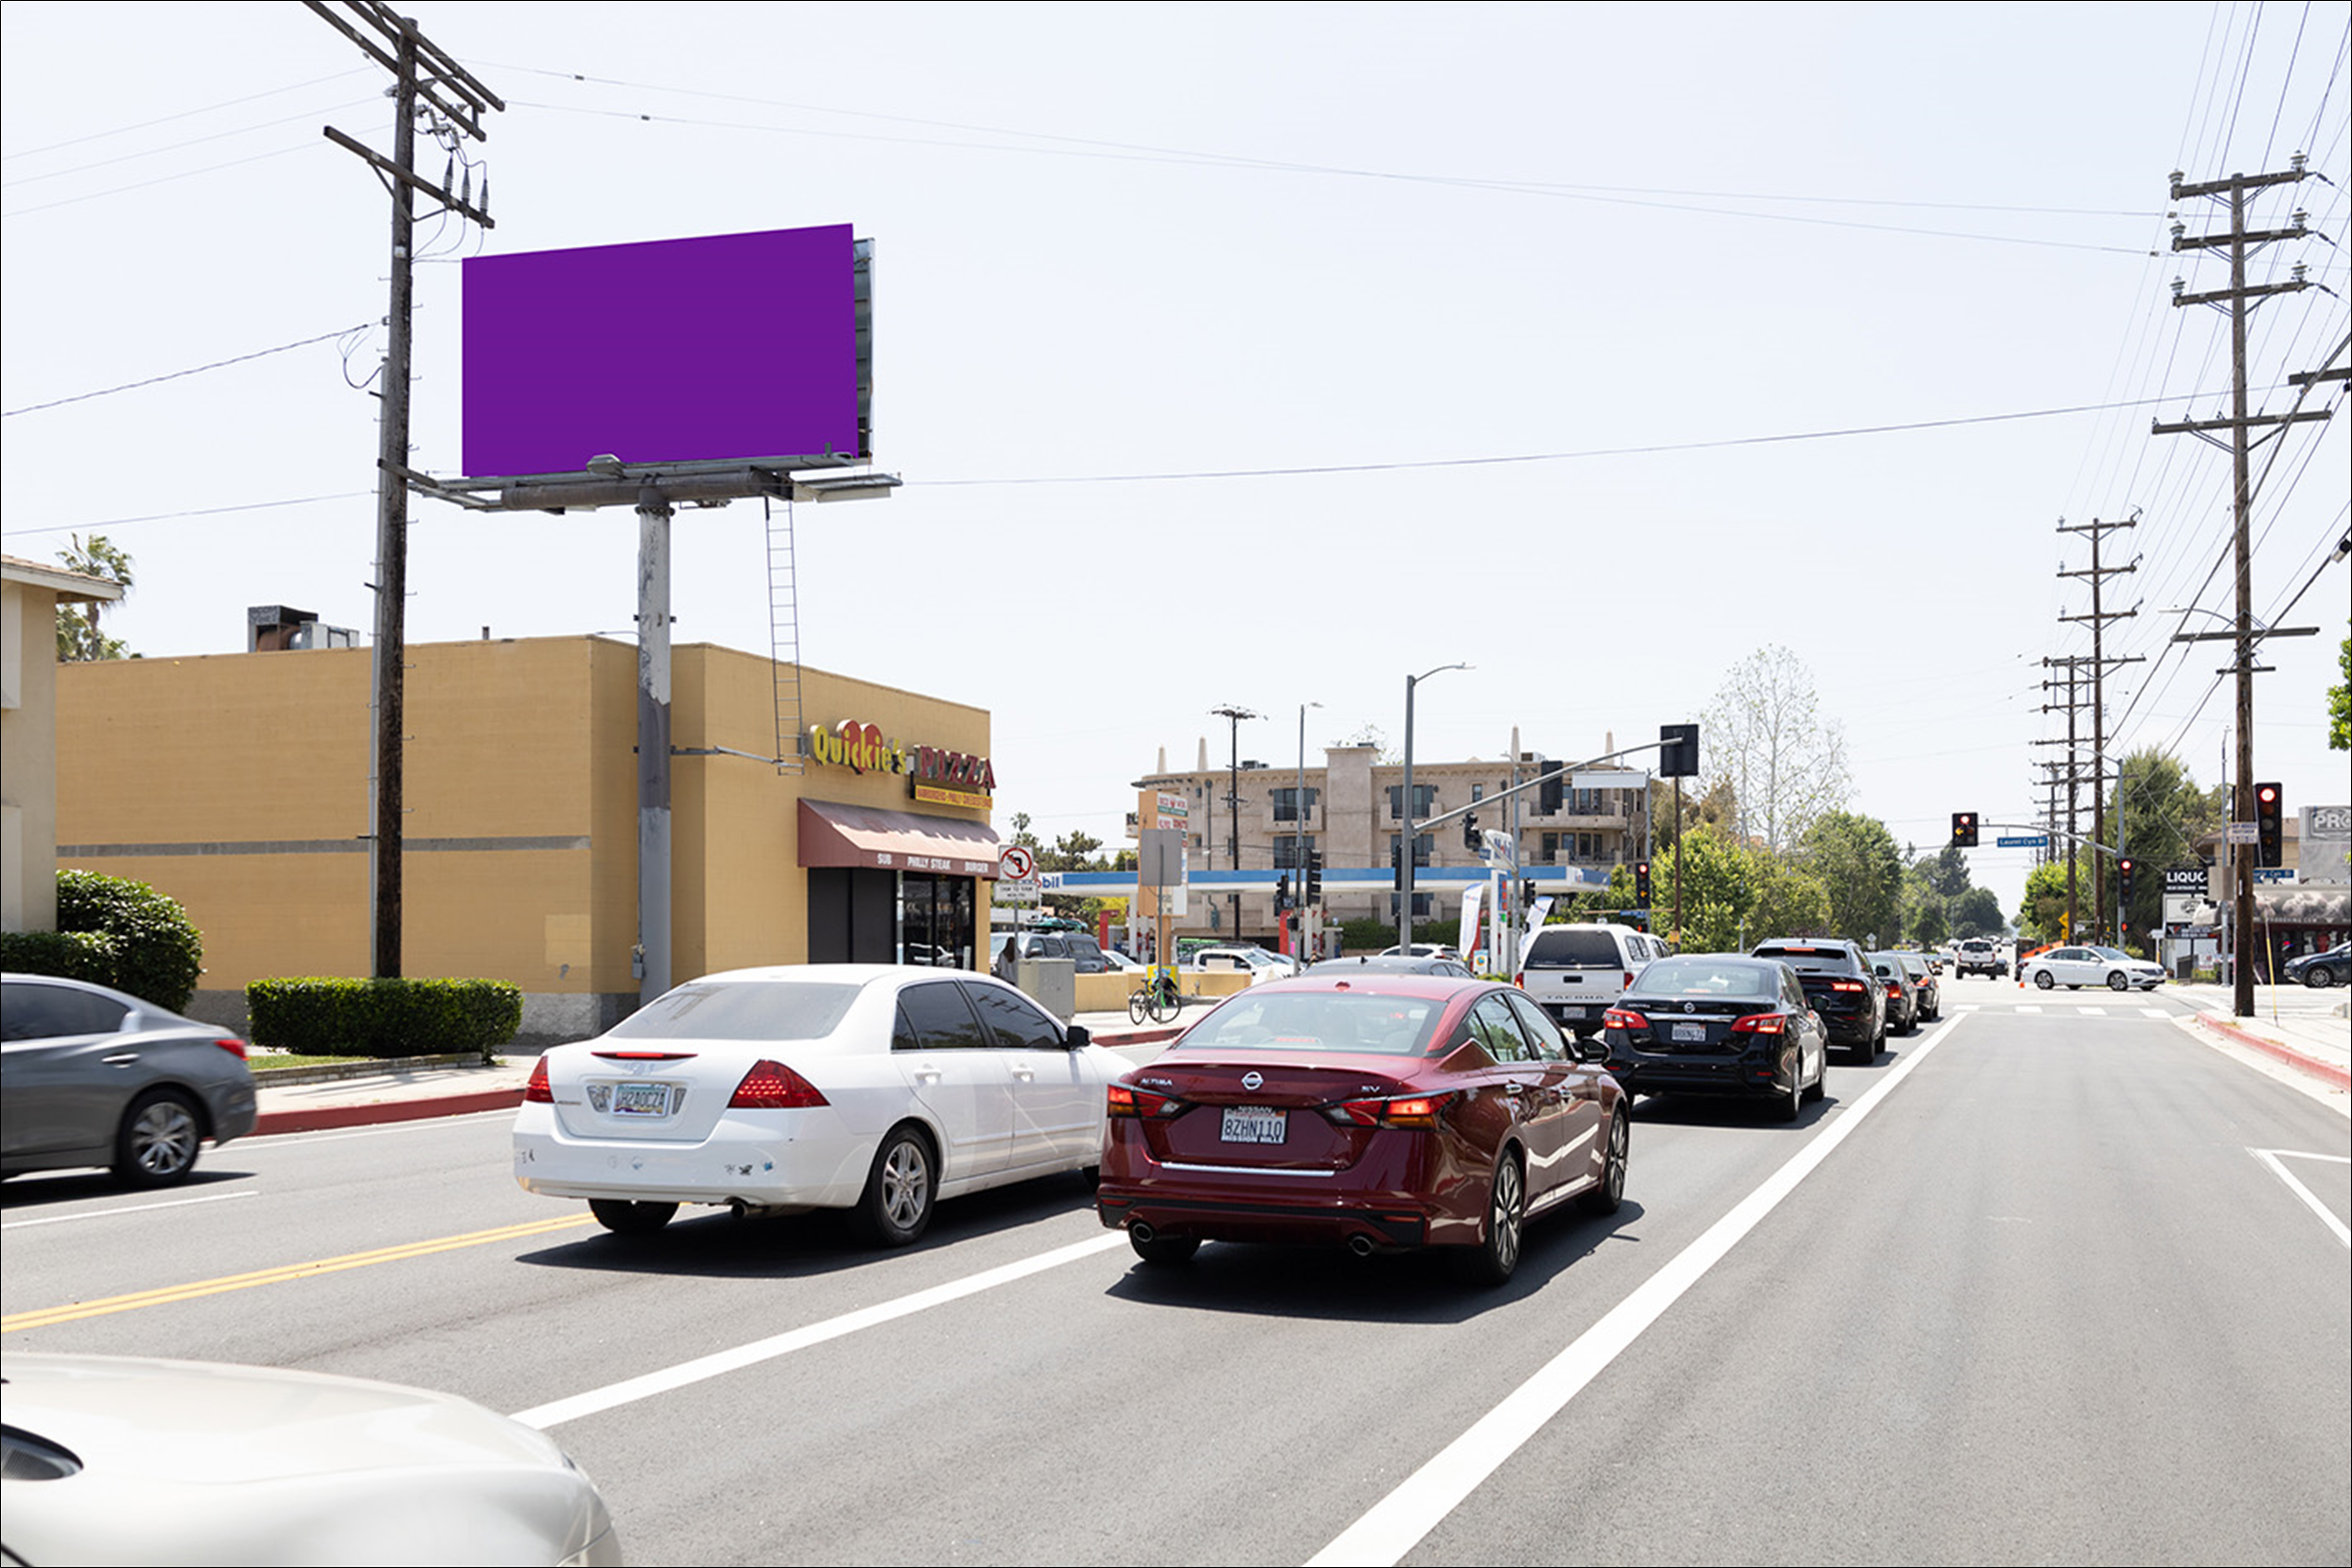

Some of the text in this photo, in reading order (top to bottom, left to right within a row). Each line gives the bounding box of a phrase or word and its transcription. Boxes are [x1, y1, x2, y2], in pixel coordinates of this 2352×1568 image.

[812, 725, 997, 789] Quickie's PIZZA
[2023, 838, 2036, 847] Cyn
[877, 853, 989, 873] SUB PHILLY STEAK BURGER
[1238, 1105, 1273, 1114] NISSAN
[1225, 1118, 1283, 1137] 8ZHN110
